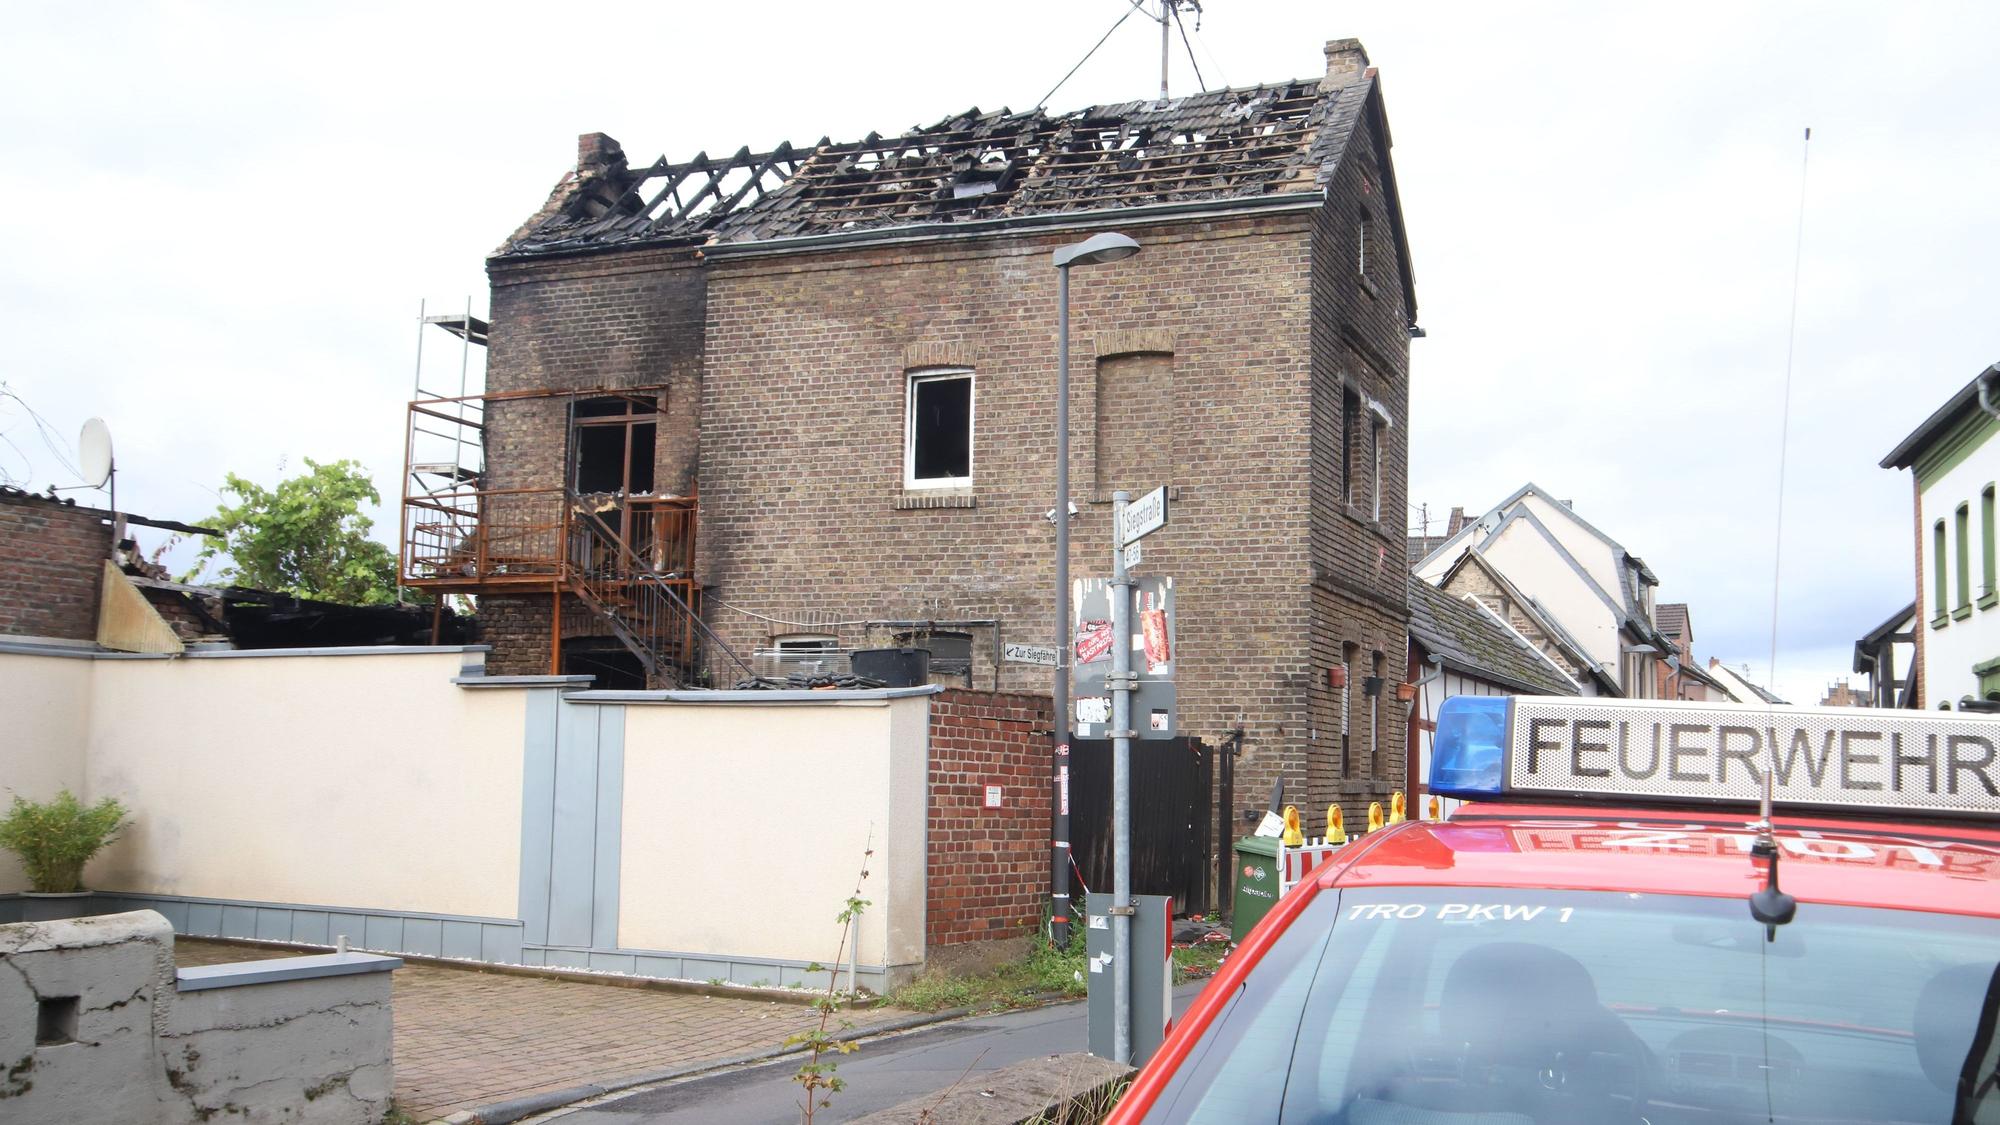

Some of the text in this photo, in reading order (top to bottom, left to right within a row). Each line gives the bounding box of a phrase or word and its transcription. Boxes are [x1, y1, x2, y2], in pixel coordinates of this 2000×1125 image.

[1126, 497, 1161, 534] Siegstraße
[1015, 647, 1026, 658] Zur
[1528, 718, 1999, 795] FEUERWEHR
[1348, 903, 1574, 922] TRO PKW 1
